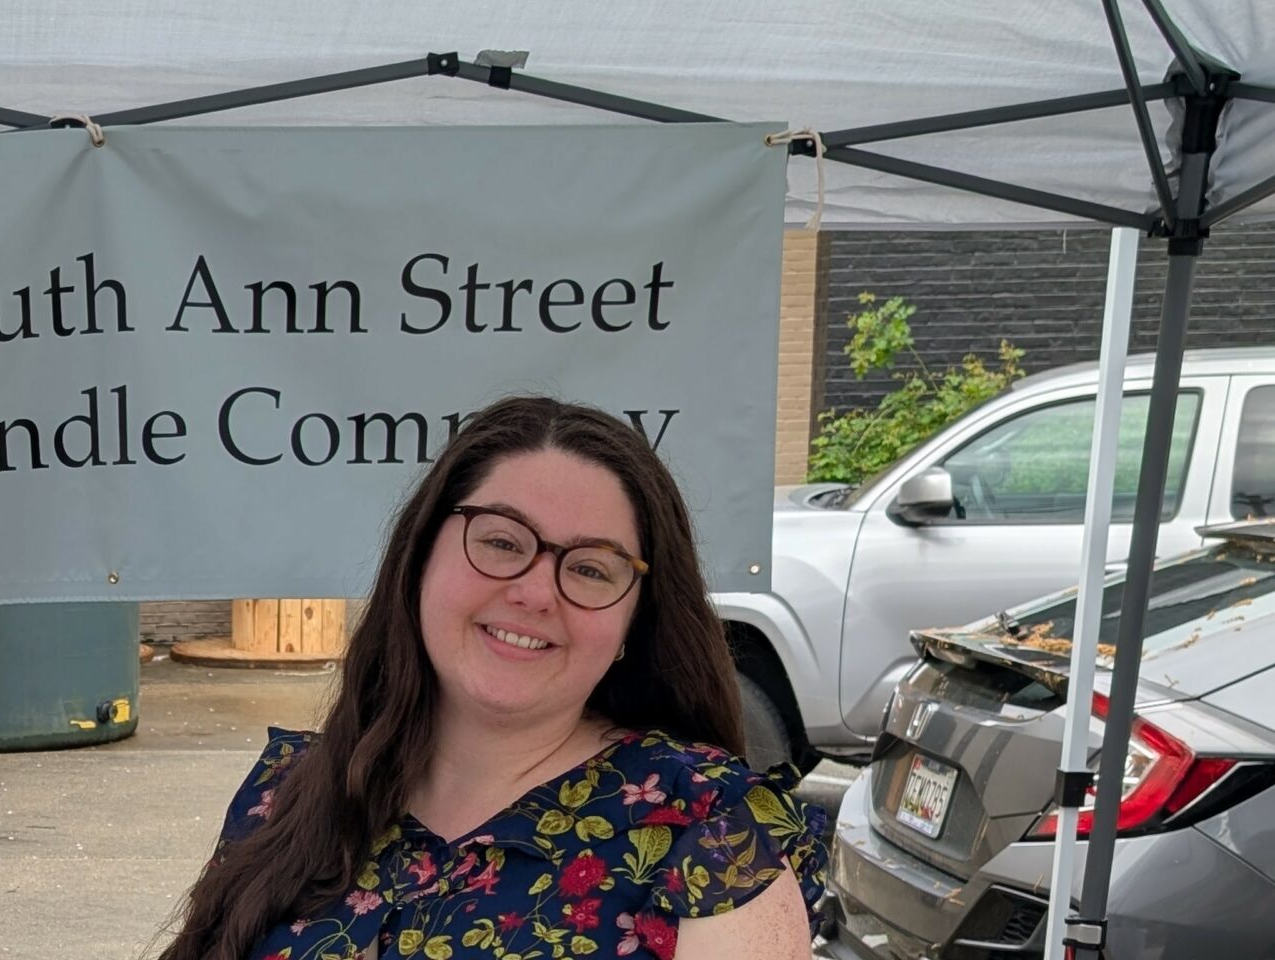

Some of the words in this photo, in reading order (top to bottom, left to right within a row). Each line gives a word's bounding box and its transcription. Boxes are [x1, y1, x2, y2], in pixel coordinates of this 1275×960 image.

[165, 253, 369, 335] Ann
[400, 252, 674, 335] Street
[218, 386, 680, 467] Comy
